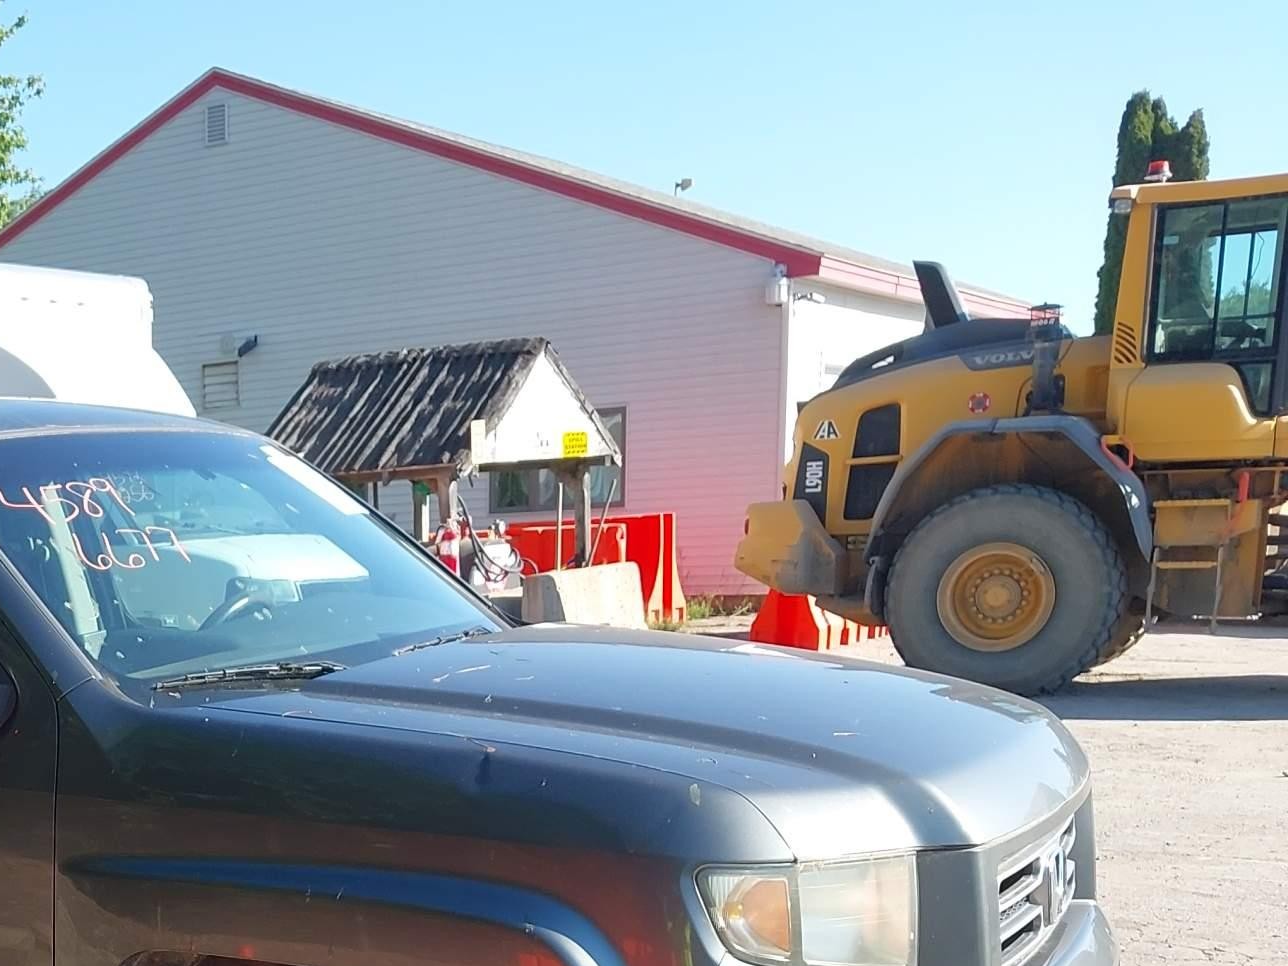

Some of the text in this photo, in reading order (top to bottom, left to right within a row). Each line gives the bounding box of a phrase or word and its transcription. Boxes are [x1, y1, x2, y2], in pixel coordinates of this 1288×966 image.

[974, 350, 1034, 365] VOLV
[805, 461, 823, 493] L90H
[72, 526, 191, 570] 6677
